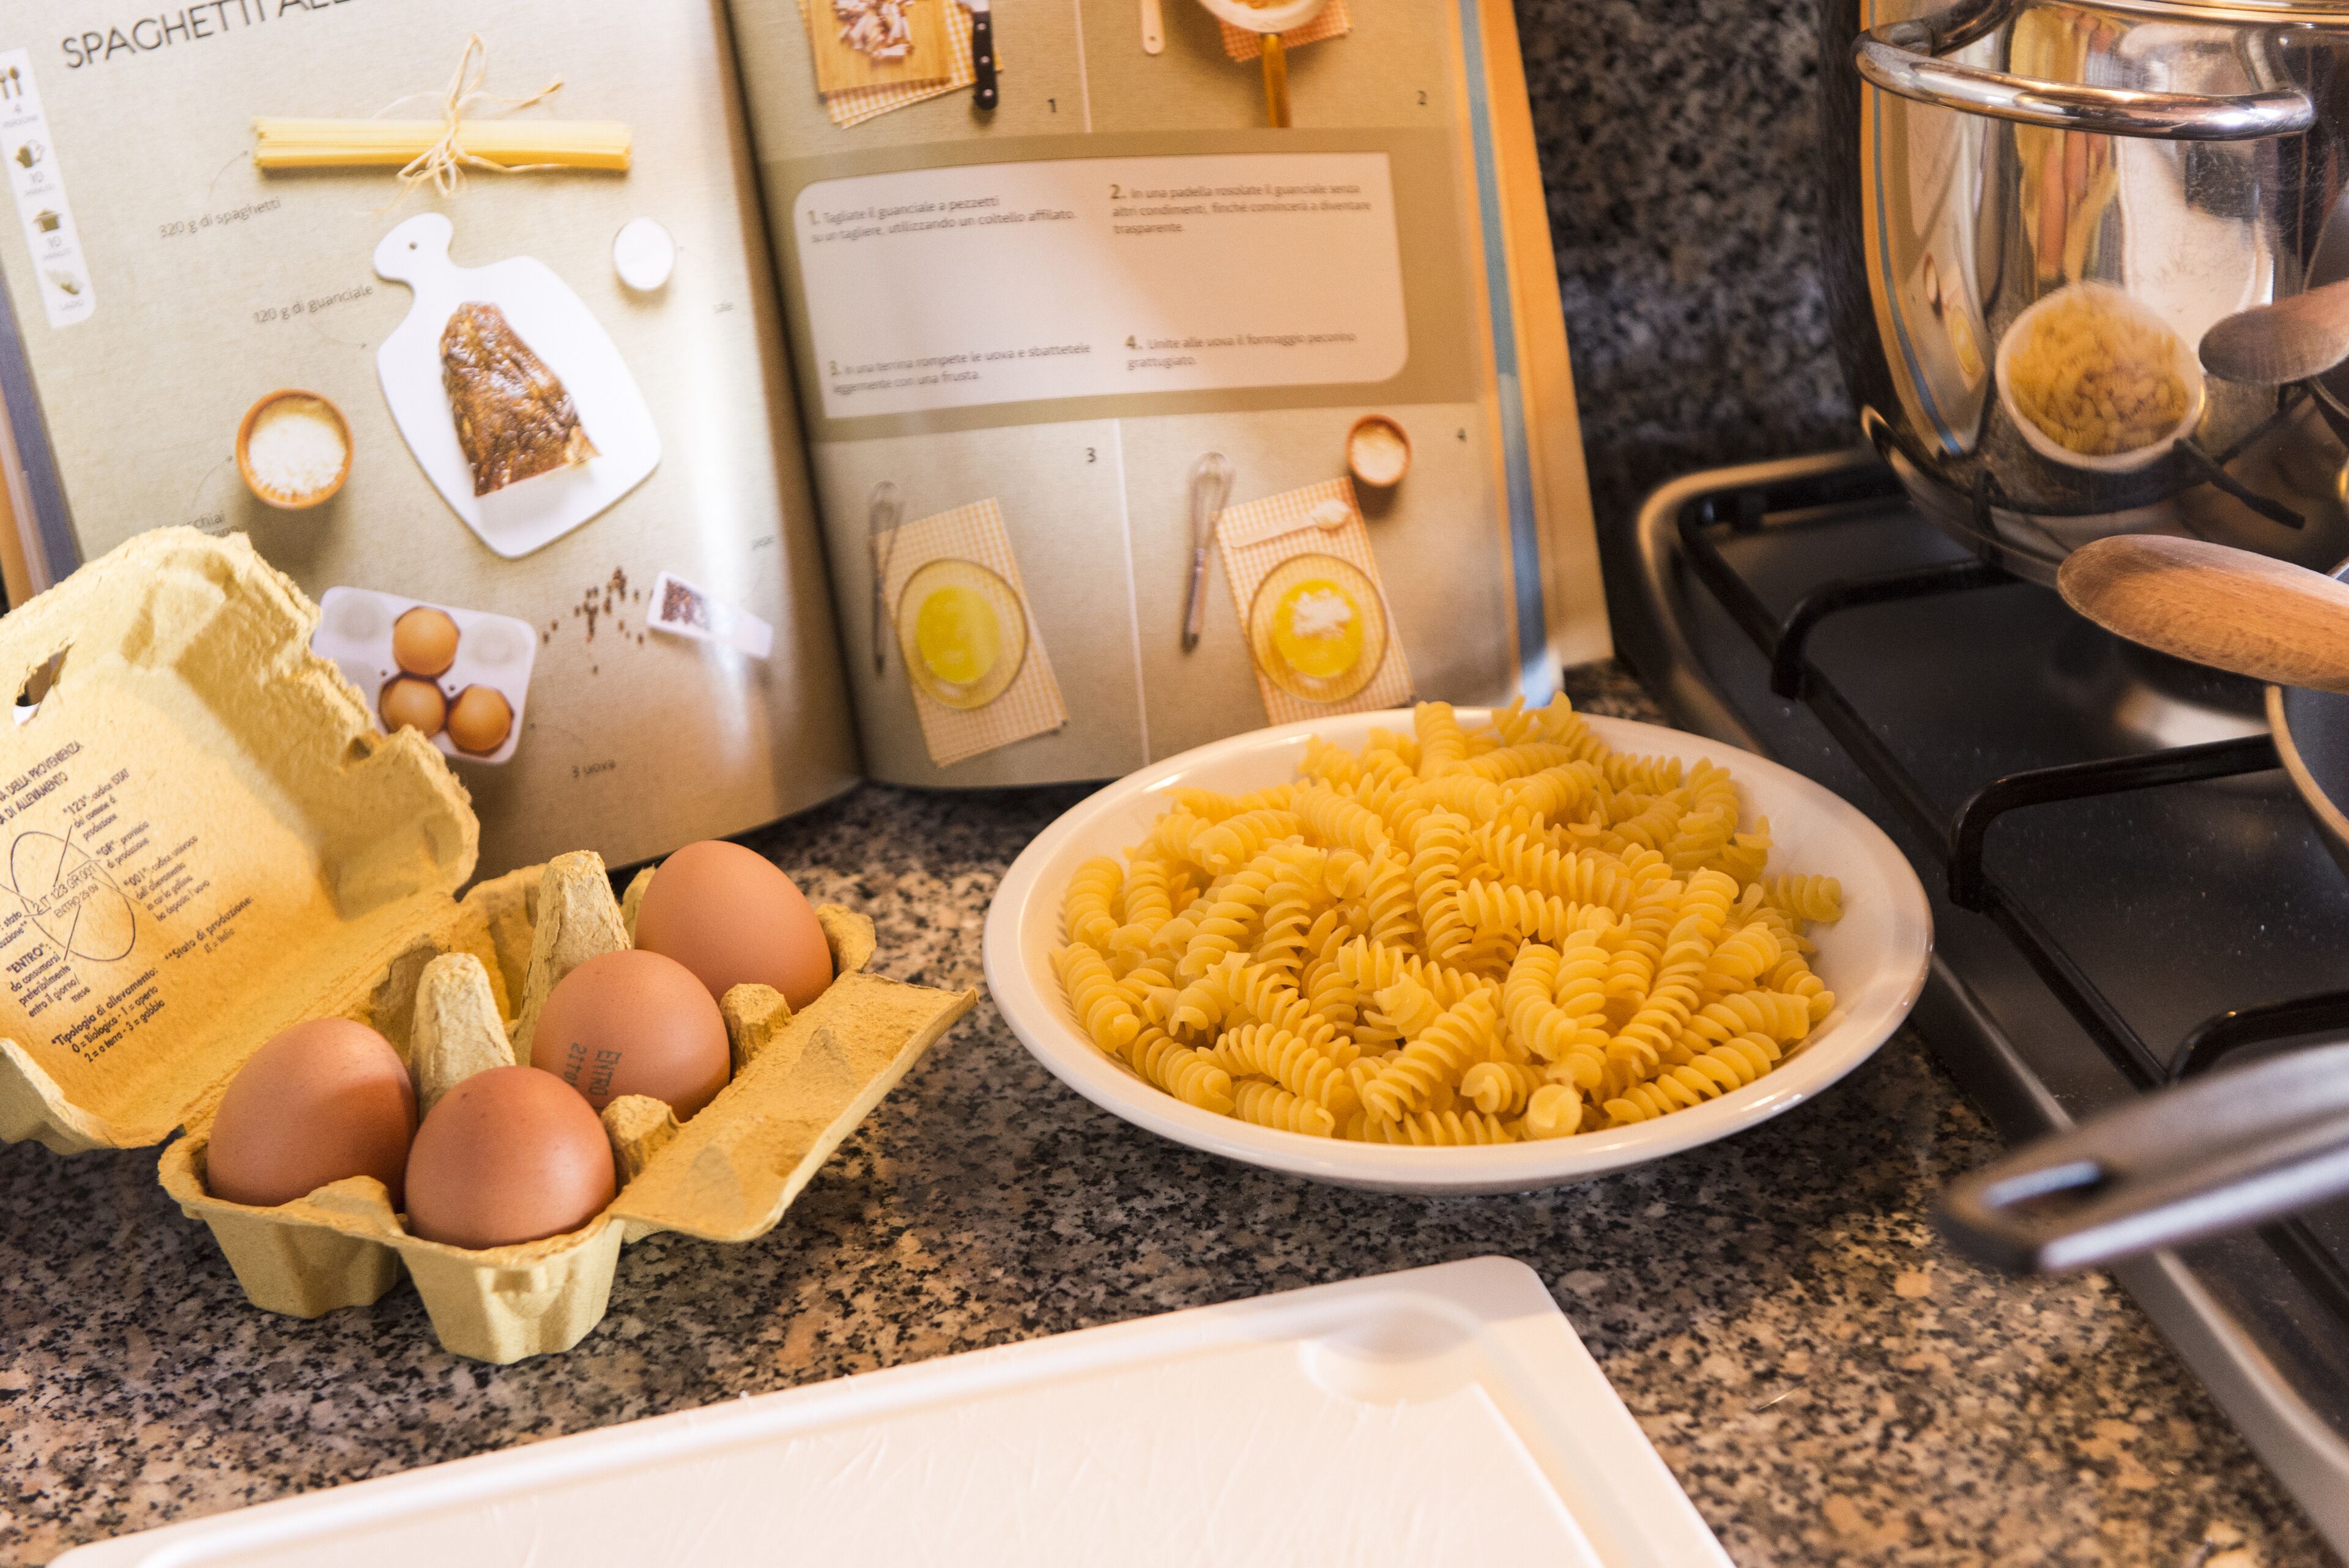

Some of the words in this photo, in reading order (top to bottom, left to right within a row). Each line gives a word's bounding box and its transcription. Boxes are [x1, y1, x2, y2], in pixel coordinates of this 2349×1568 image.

[62, 0, 265, 69] SPAGHETTI
[1047, 98, 1057, 113] 1
[1417, 90, 1427, 106] 2
[1110, 184, 1126, 199] 2.
[1145, 190, 1168, 198] una
[1170, 185, 1212, 199] padella
[1215, 184, 1261, 195] rosolate
[1274, 182, 1327, 197] guanciale
[1330, 185, 1360, 194] senza
[158, 221, 184, 238] 320
[188, 221, 198, 234] g
[200, 213, 213, 227] di
[215, 196, 281, 225] spaghetti
[823, 211, 866, 225] Tagliate
[867, 206, 875, 217] il
[877, 201, 936, 220] guanciale
[939, 202, 946, 210] a
[948, 195, 1000, 212] pezzetti
[889, 217, 956, 233] utilizzando
[959, 217, 974, 226] un
[979, 211, 1025, 225] coltello
[1028, 209, 1077, 221] affilato.
[1113, 205, 1136, 216] altri
[1320, 199, 1371, 211] diventare
[253, 307, 278, 324] 120
[281, 308, 290, 321] g
[292, 301, 305, 314] di
[308, 284, 373, 313] guanciale
[1182, 337, 1203, 347] alle
[1206, 338, 1234, 347] uova
[1246, 333, 1304, 347] formaggio
[916, 354, 967, 368] rompete
[970, 351, 982, 362] le
[984, 350, 1014, 360] uova
[1028, 342, 1091, 357] sbattetele
[918, 375, 940, 384] una
[1086, 447, 1096, 463] 3
[5, 773, 32, 795] DELLA
[28, 740, 84, 780] PROVENIENZA
[571, 764, 580, 779] 3
[583, 759, 616, 775] uova
[5, 805, 17, 819] DI
[16, 771, 68, 812] ALLEVAMENTO
[92, 783, 113, 801] codice
[111, 768, 130, 786] ISTAT
[75, 816, 86, 828] del
[86, 801, 109, 820] comune
[83, 812, 117, 842] produzione
[121, 821, 149, 845] provincia
[115, 837, 150, 866] produzione
[152, 856, 172, 871] codice
[173, 836, 198, 856] univoco
[32, 902, 43, 914] 2
[39, 895, 51, 908] IT
[50, 883, 69, 901] 123
[66, 874, 81, 890] GR
[80, 863, 97, 880] 001
[149, 861, 186, 891] allevamento
[54, 894, 81, 918] ENTRO
[144, 902, 153, 912] in
[154, 896, 164, 905] cui
[172, 874, 193, 895] gallina
[165, 894, 190, 912] deposto
[4, 911, 22, 927] stato
[196, 929, 206, 941] di
[206, 896, 253, 936] produzione:
[217, 928, 235, 944] Italia
[10, 981, 22, 992] da
[22, 951, 61, 984] consumarsi
[19, 964, 71, 1007] preferibilmente
[29, 1001, 48, 1017] entro
[45, 992, 54, 1003] il
[71, 986, 91, 1003] mese
[96, 1004, 106, 1016] di
[106, 967, 158, 1009] allevamento:
[84, 1017, 118, 1043] Biologico
[121, 1006, 128, 1015] 1
[135, 986, 158, 1006] aperto
[84, 1052, 94, 1063] 2
[104, 1031, 123, 1048] terra
[126, 1021, 134, 1031] 3
[139, 999, 165, 1024] gabbia
